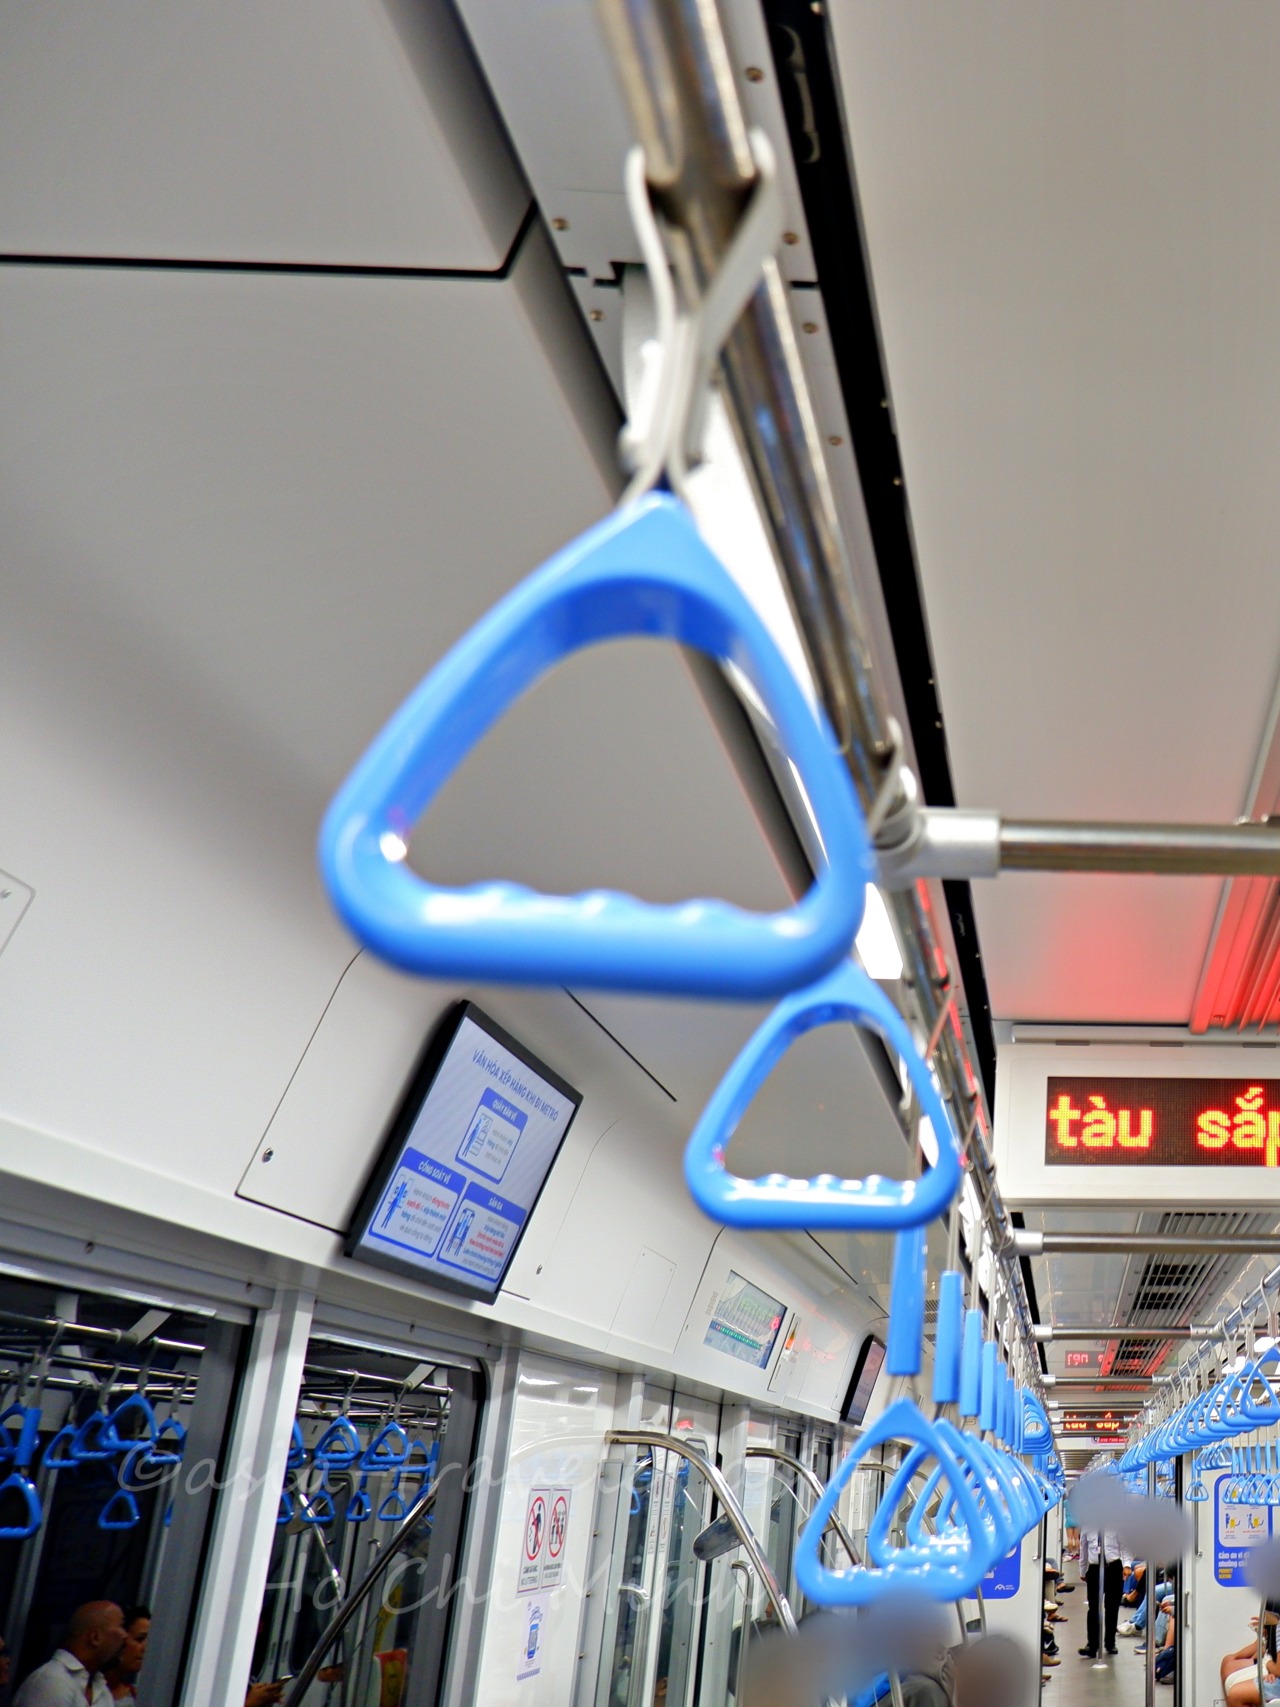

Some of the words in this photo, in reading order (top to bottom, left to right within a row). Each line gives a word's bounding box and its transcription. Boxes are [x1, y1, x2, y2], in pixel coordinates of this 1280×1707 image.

[485, 1059, 499, 1078] HÓA
[525, 1089, 536, 1106] KHI
[540, 1101, 559, 1122] METRO
[1050, 1096, 1152, 1147] tàu
